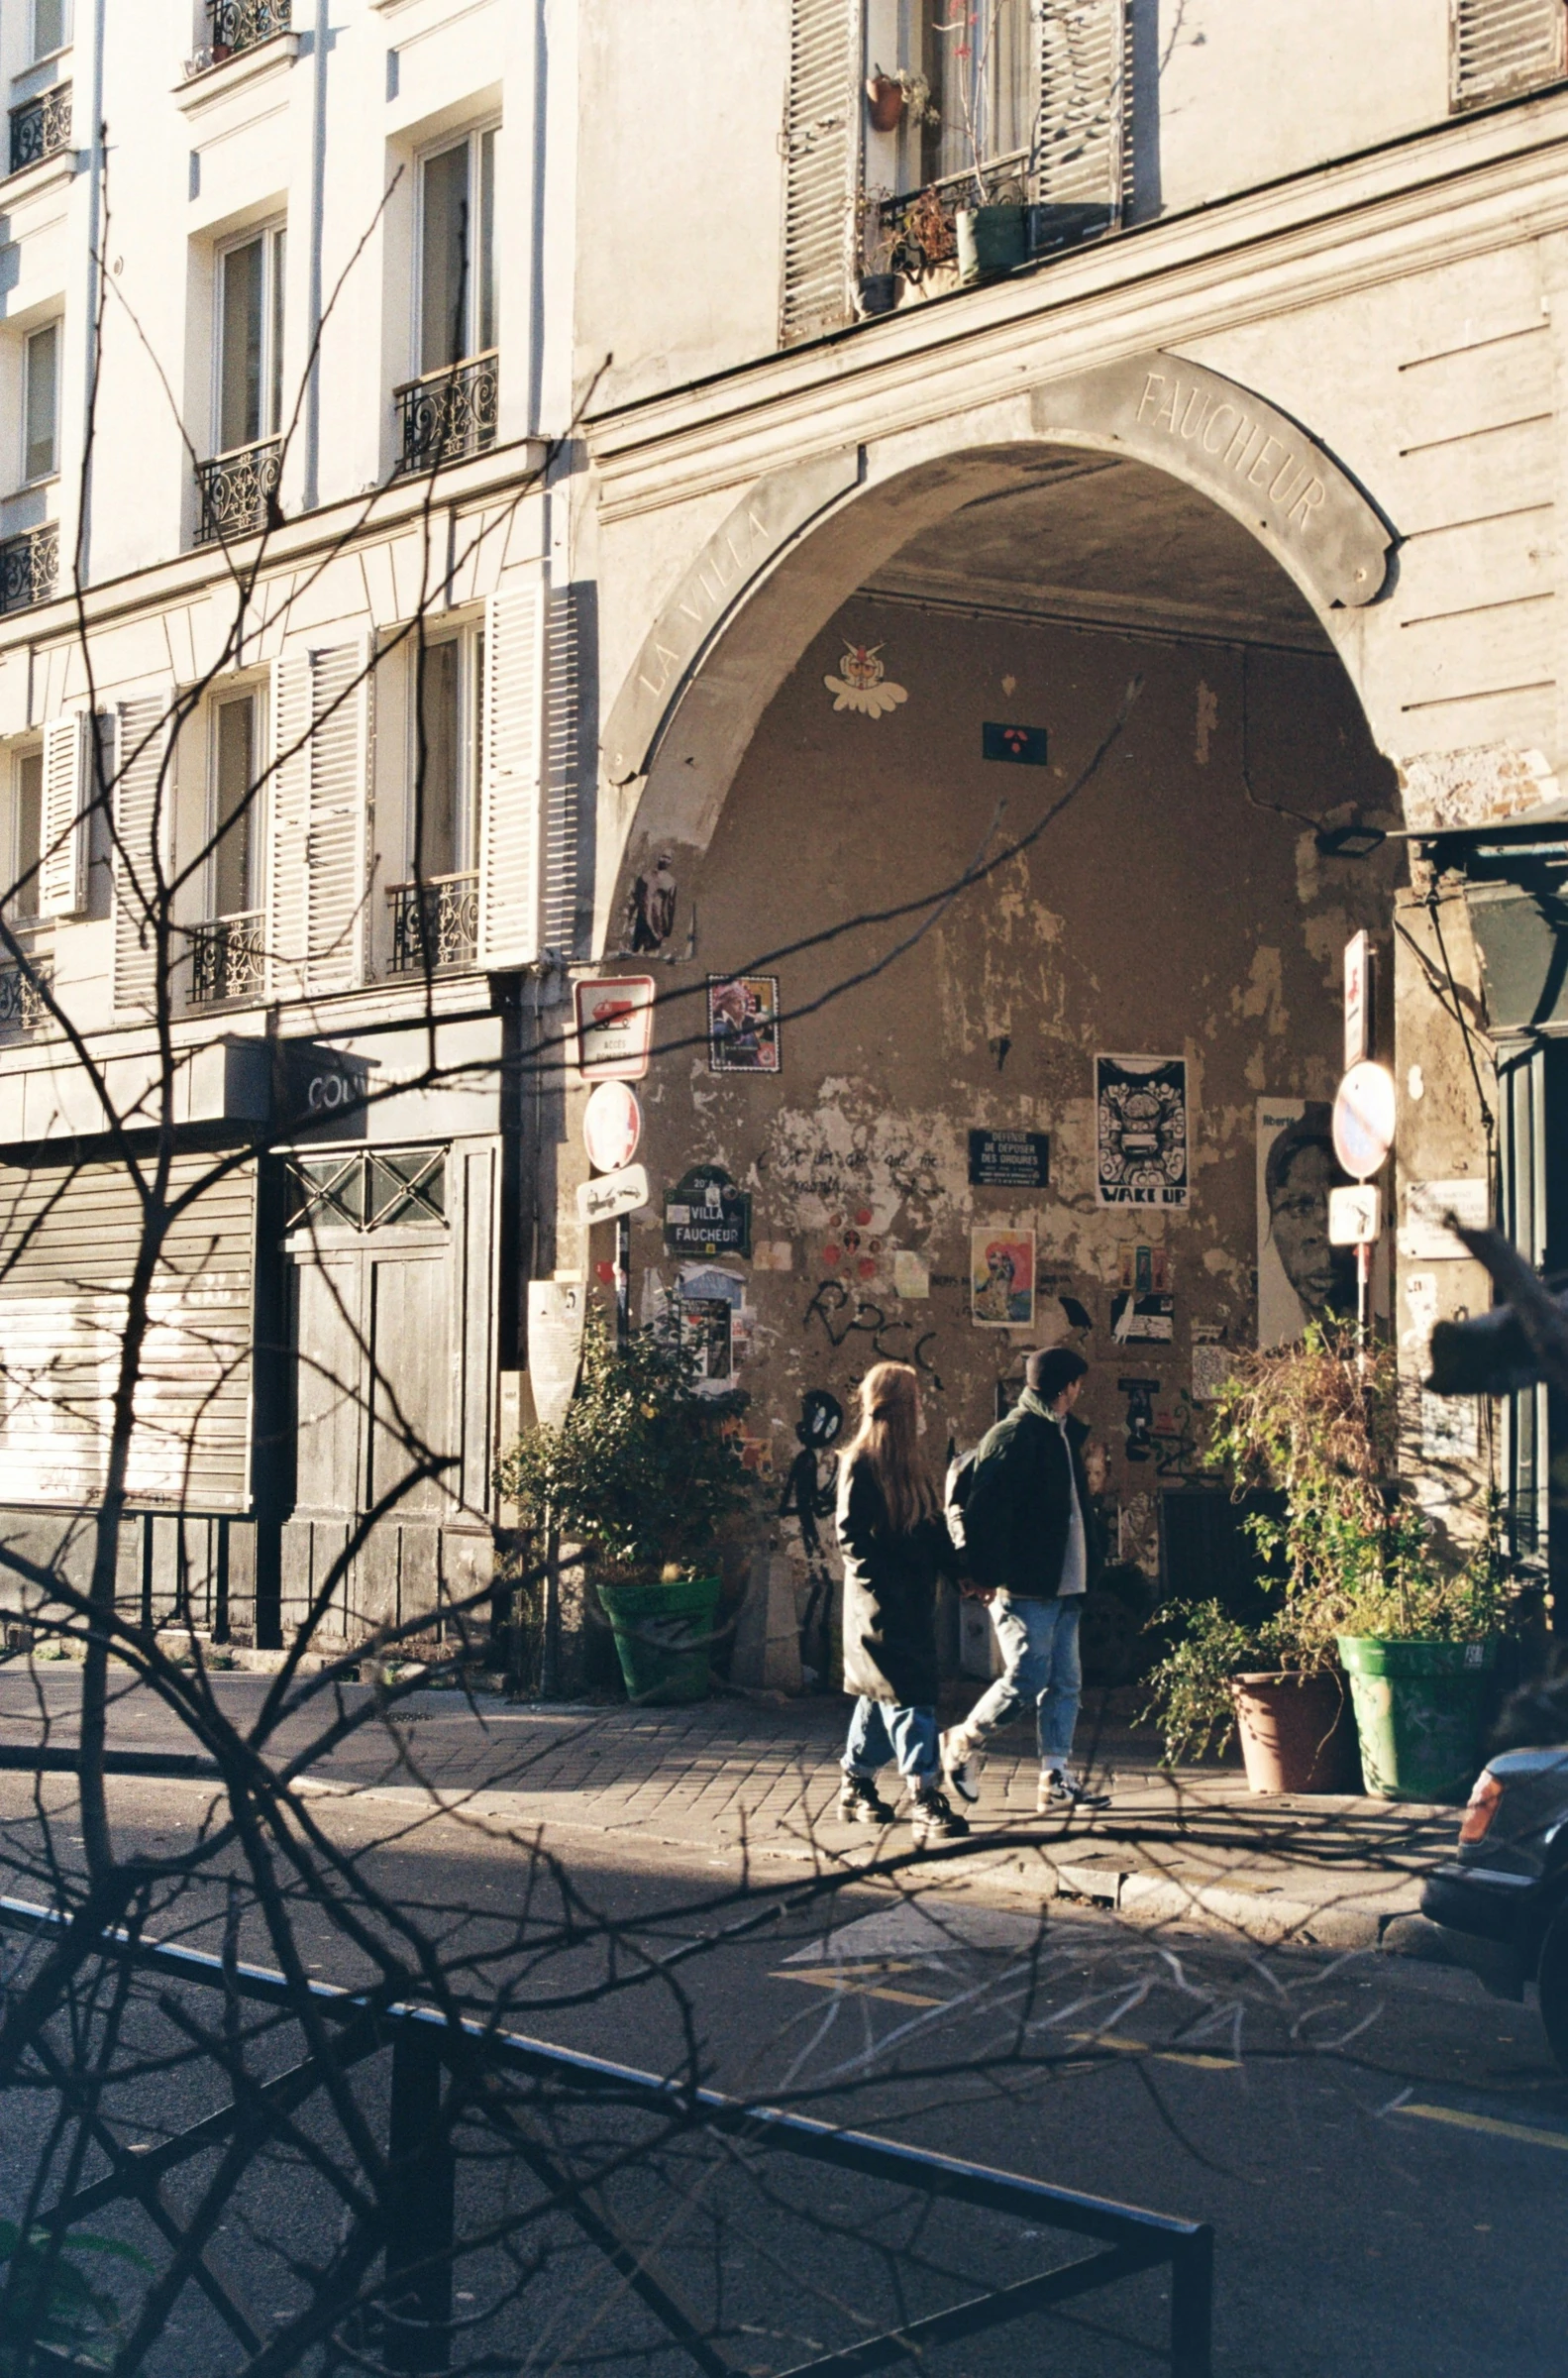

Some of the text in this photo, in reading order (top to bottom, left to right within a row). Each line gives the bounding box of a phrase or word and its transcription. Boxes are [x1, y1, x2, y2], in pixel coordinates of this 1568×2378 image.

[1136, 371, 1326, 533] FAUCHEUR
[639, 510, 769, 696] LA VILLA
[985, 1142, 994, 1152] DE
[982, 1153, 997, 1163] DES
[1100, 1187, 1187, 1204] WAKE UP
[691, 1206, 724, 1221] VILLA
